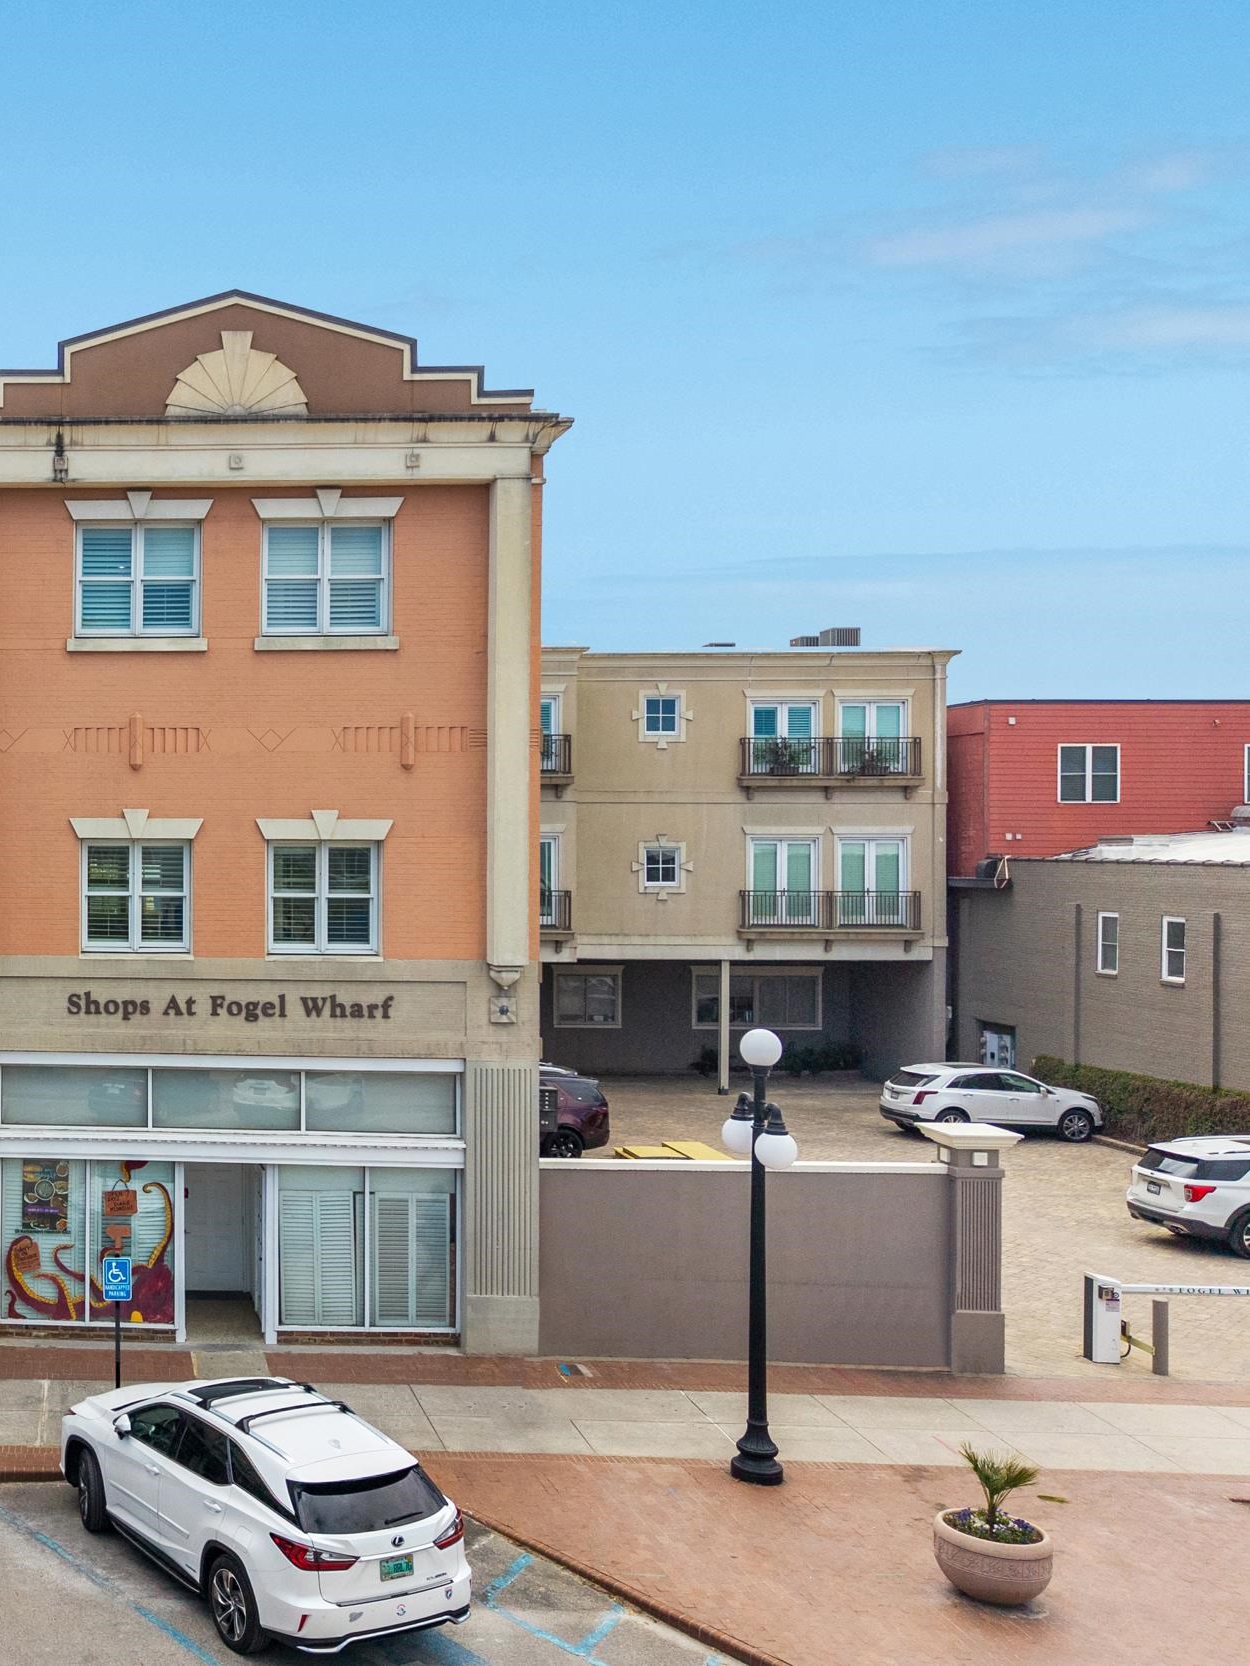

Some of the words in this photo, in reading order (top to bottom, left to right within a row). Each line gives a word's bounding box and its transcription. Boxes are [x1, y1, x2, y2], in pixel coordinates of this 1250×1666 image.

[67, 991, 150, 1021] Shops
[162, 995, 197, 1016] At
[209, 994, 287, 1022] Fogel
[300, 994, 394, 1019] Wharf
[1179, 1287, 1224, 1295] FOGEL
